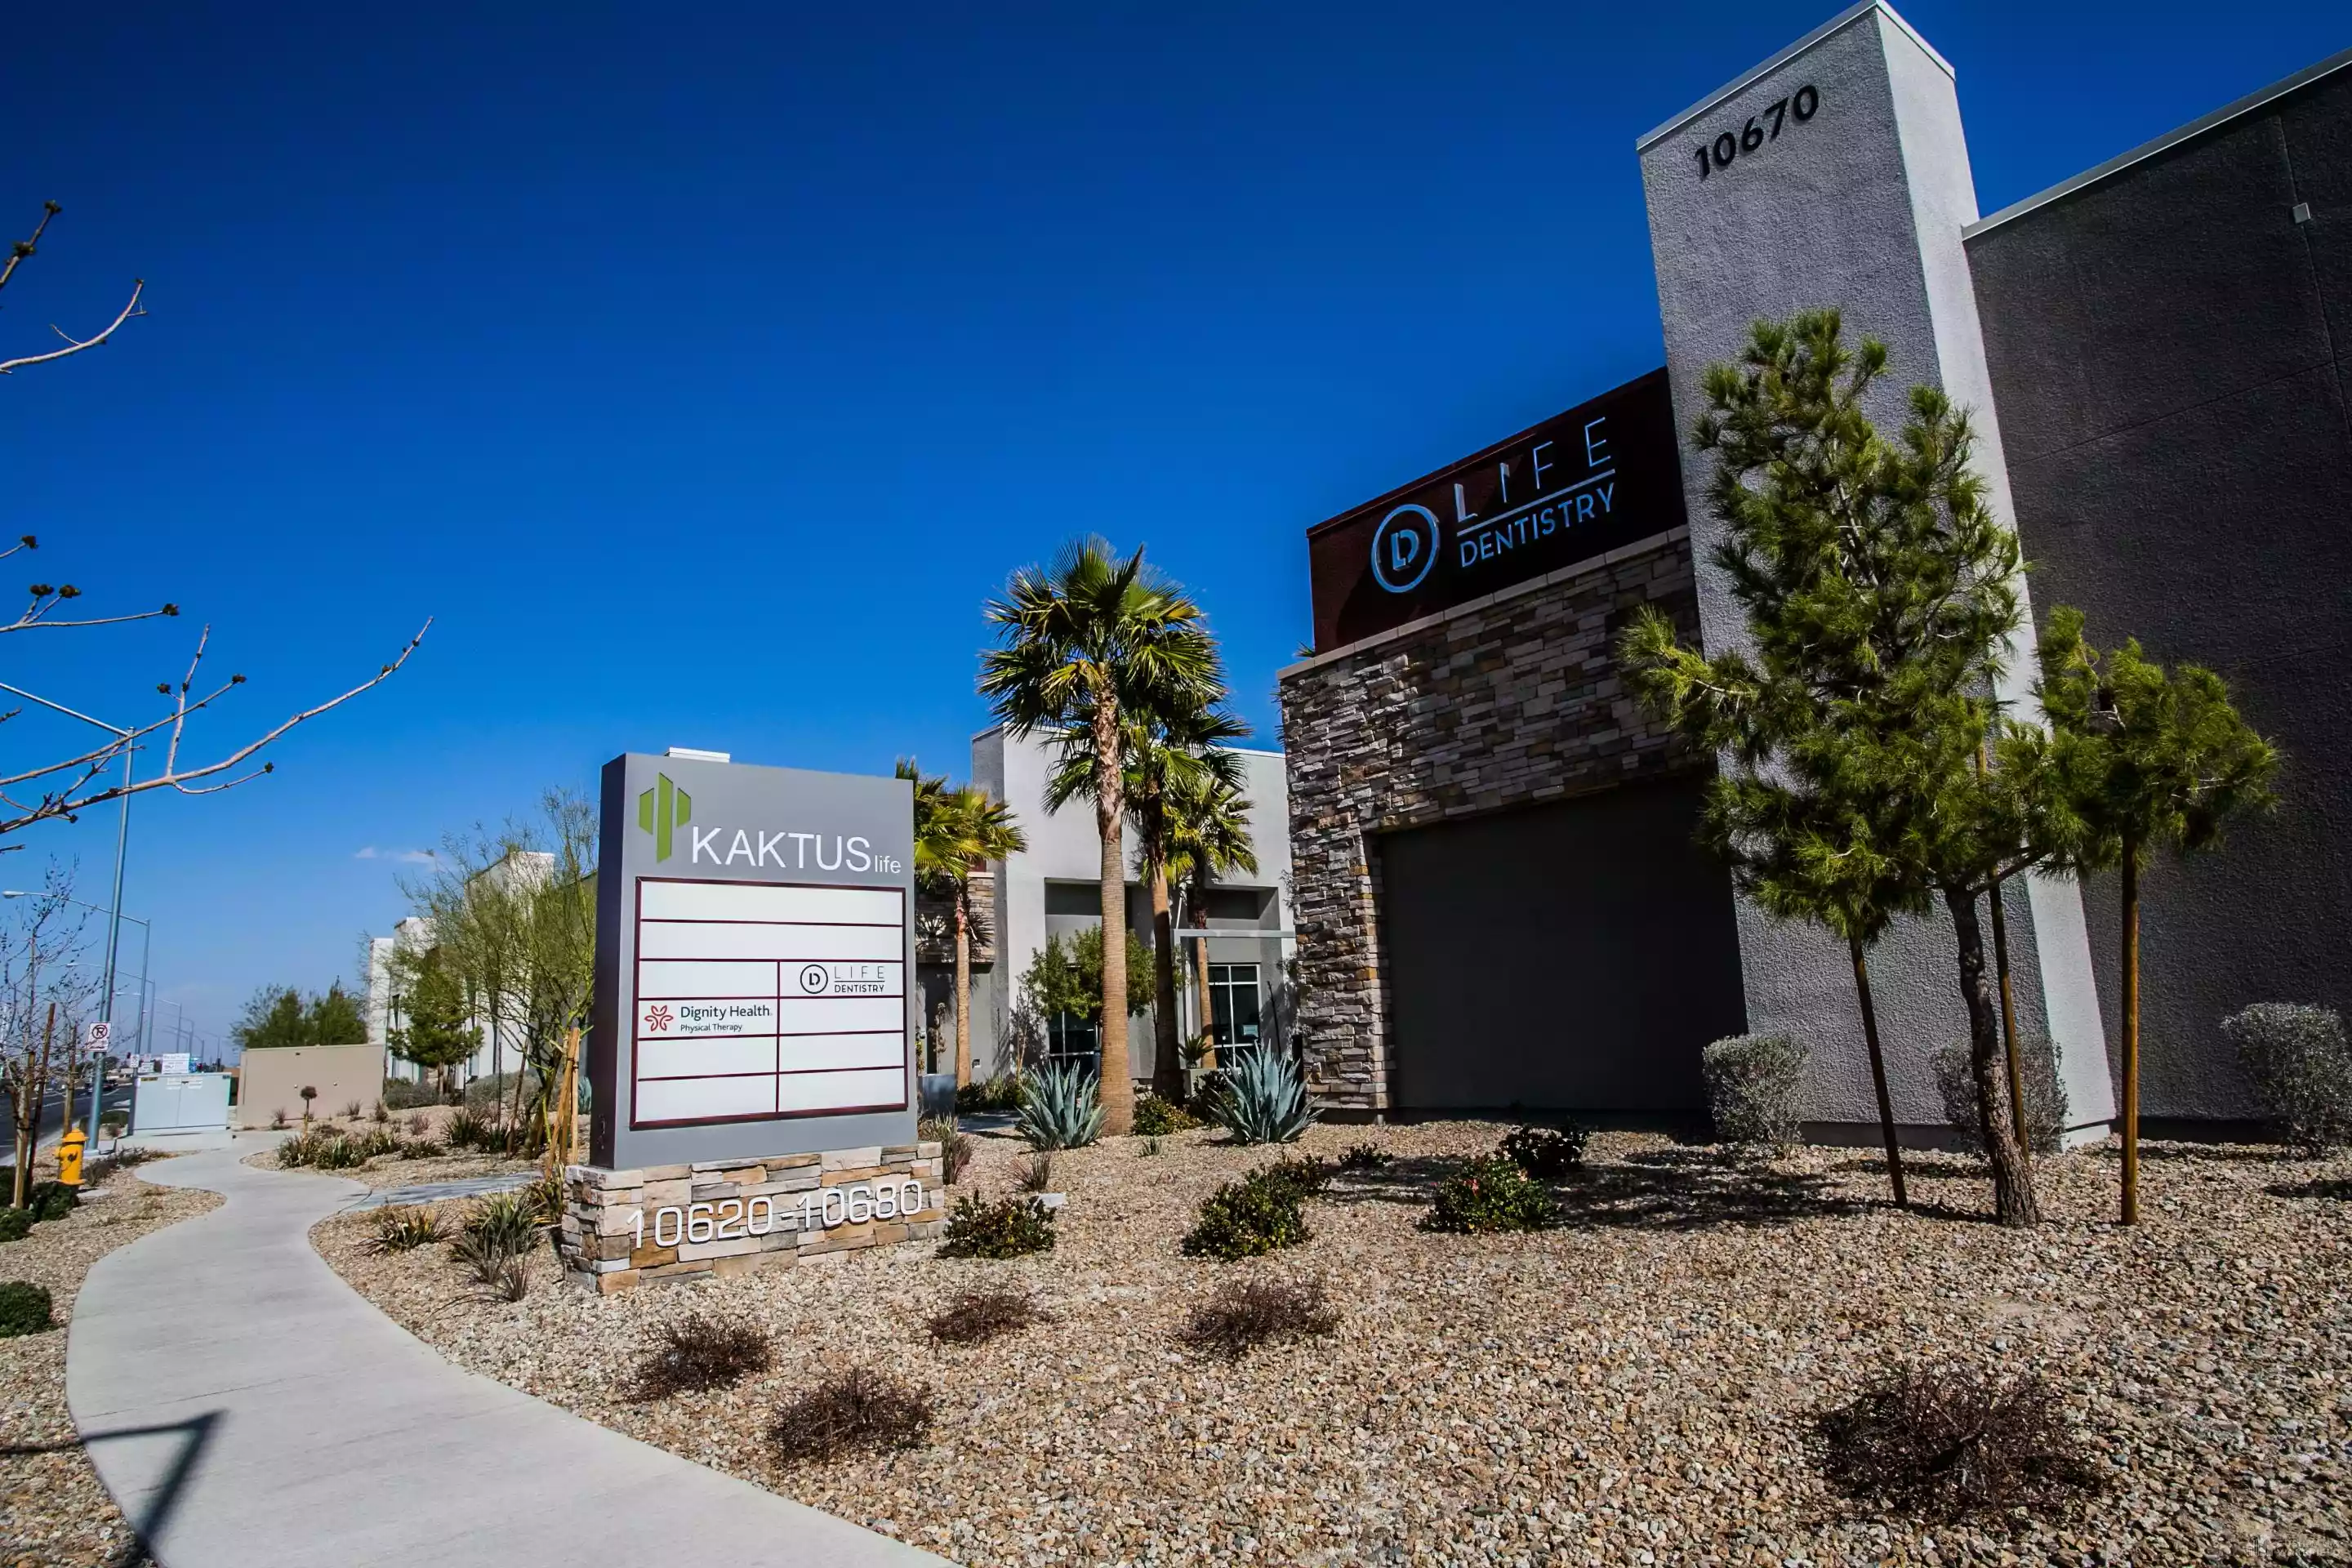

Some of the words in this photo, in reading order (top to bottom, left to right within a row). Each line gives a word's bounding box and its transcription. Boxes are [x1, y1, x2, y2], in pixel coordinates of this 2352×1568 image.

[1695, 85, 1819, 179] 10670
[1454, 416, 1611, 523] LIFE
[1459, 482, 1615, 568] DENTISTRY
[693, 826, 871, 872] KAKTUS
[875, 855, 902, 873] life
[834, 966, 884, 979] LIFE
[834, 984, 884, 993] DENTISTRY
[680, 1006, 727, 1021] Dignity
[680, 1023, 710, 1033] Physical
[713, 1022, 742, 1032] Therapy
[626, 1180, 923, 1250] 10620-10680
